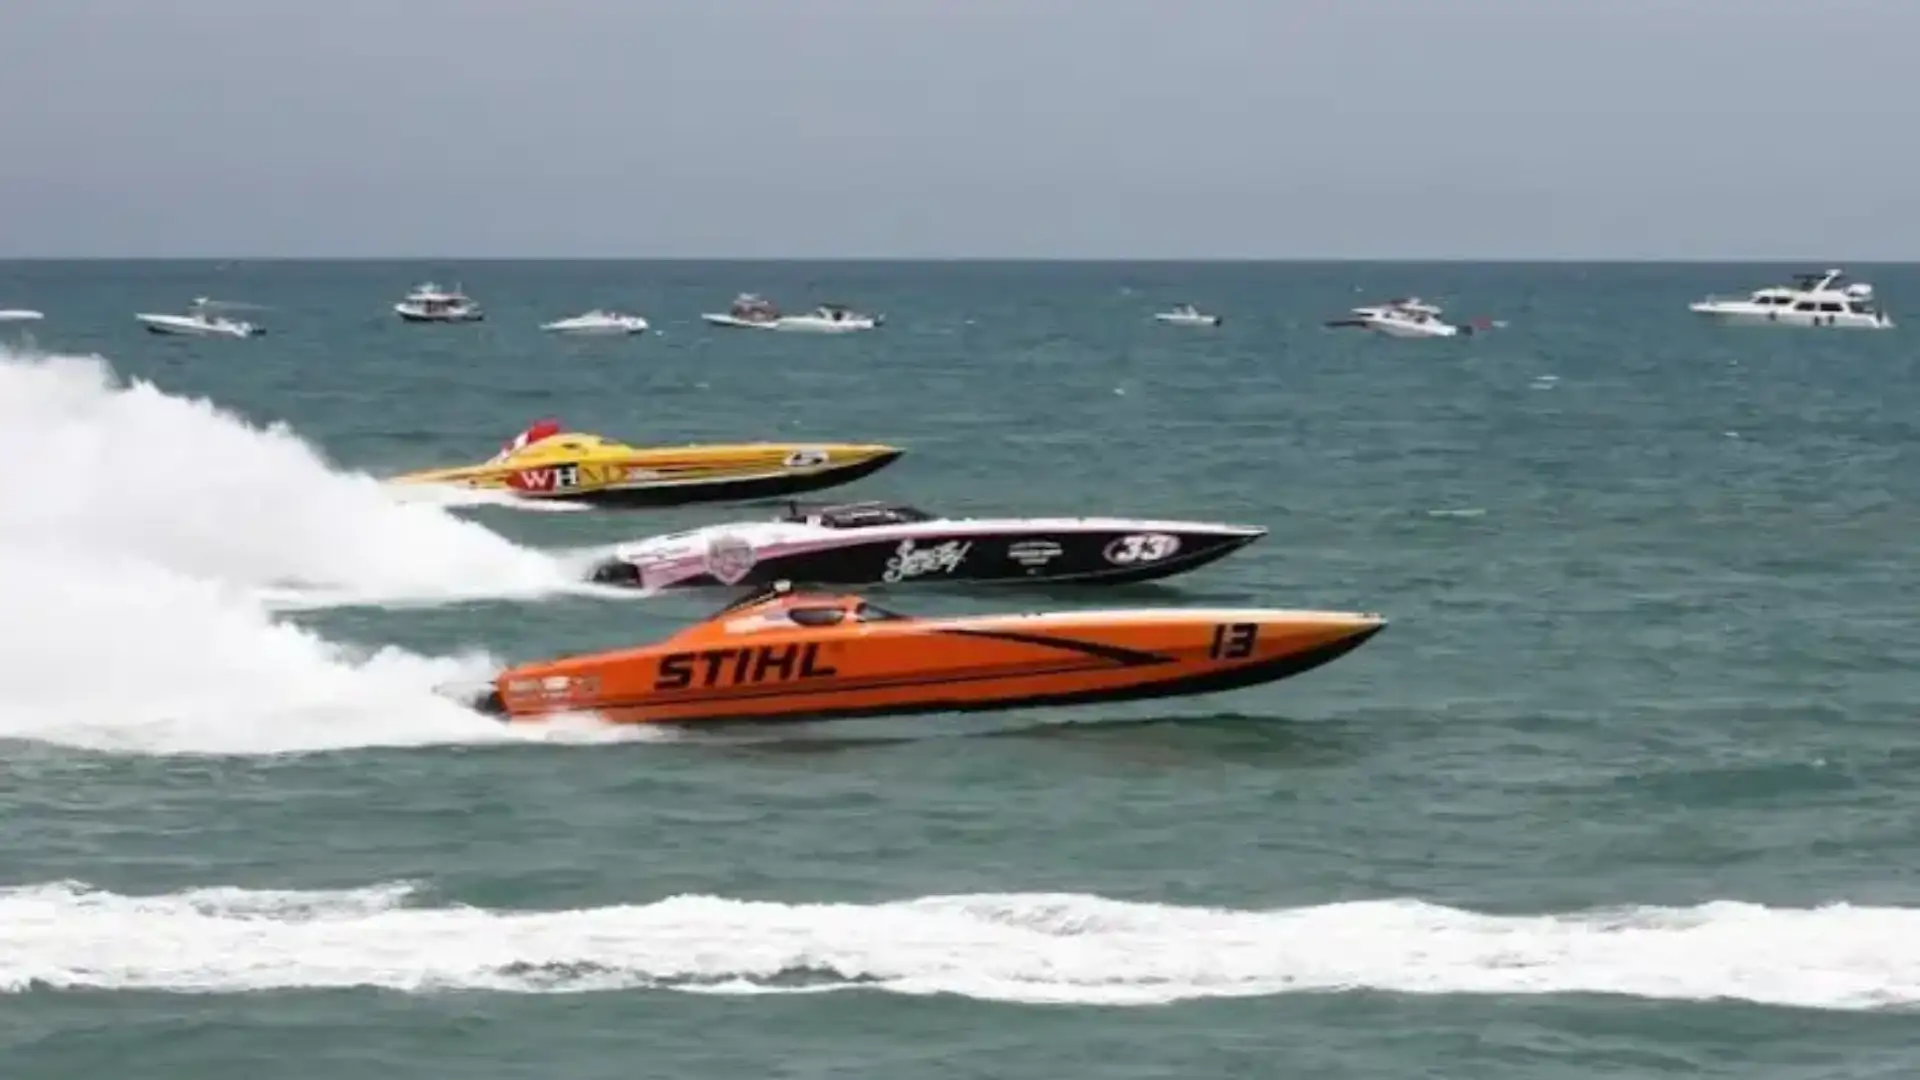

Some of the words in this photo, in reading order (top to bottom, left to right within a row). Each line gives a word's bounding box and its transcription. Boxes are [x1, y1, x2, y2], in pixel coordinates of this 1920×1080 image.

[1114, 535, 1164, 562] 33
[1209, 622, 1258, 660] 13
[654, 642, 838, 691] STIHL
